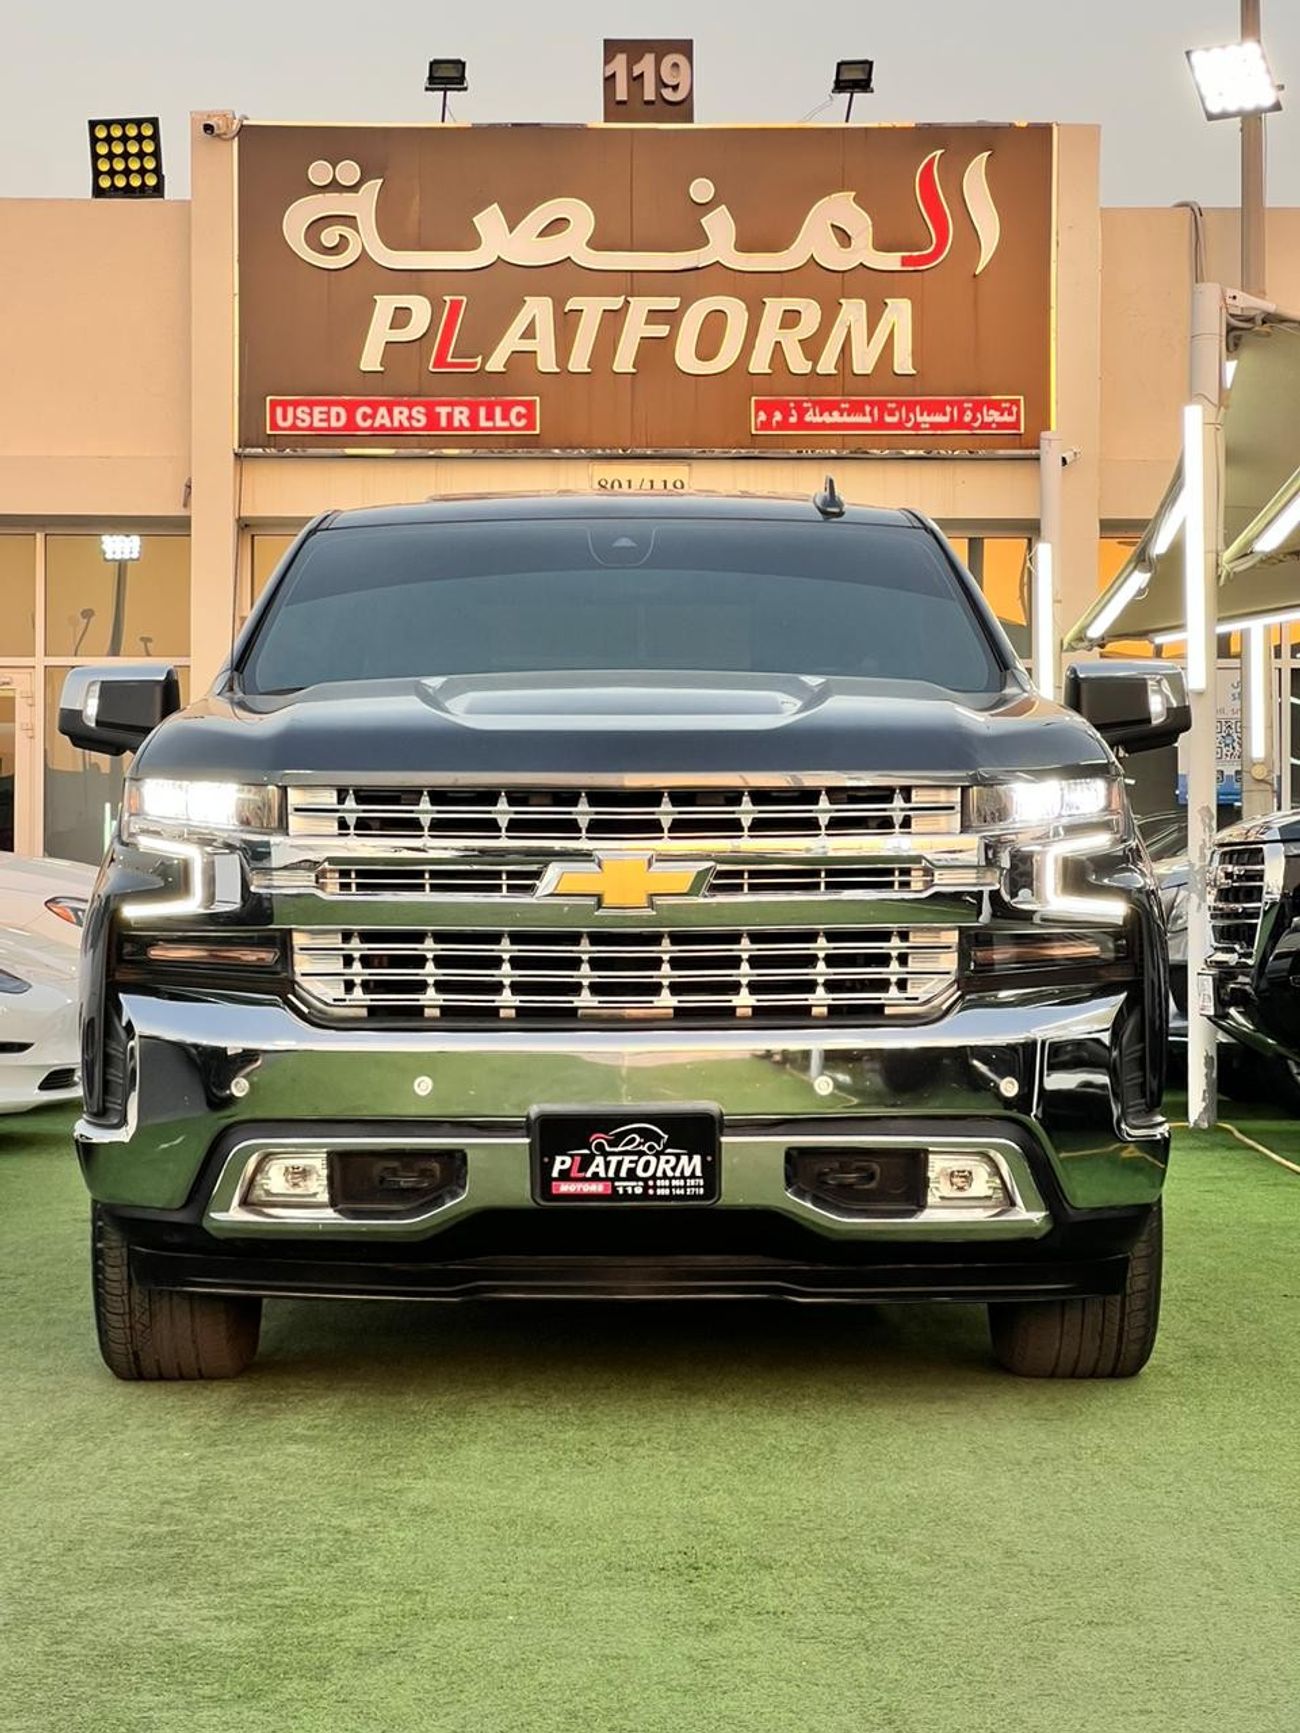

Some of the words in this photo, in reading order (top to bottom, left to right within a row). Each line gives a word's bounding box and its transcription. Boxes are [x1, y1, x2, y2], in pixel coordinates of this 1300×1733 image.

[604, 52, 692, 102] 119
[282, 149, 1001, 277] المنصة
[359, 294, 918, 376] PLATFORM
[275, 405, 347, 428] USED
[355, 405, 427, 428] CARS
[435, 405, 471, 428] TR
[478, 405, 528, 428] LLC
[755, 408, 767, 428] م
[771, 408, 783, 428] م
[787, 402, 798, 424] ذ
[803, 402, 878, 424] المستعملة
[883, 402, 958, 429] السيارات
[962, 402, 1019, 429] لتجارة
[551, 1155, 703, 1178] PLATFORM
